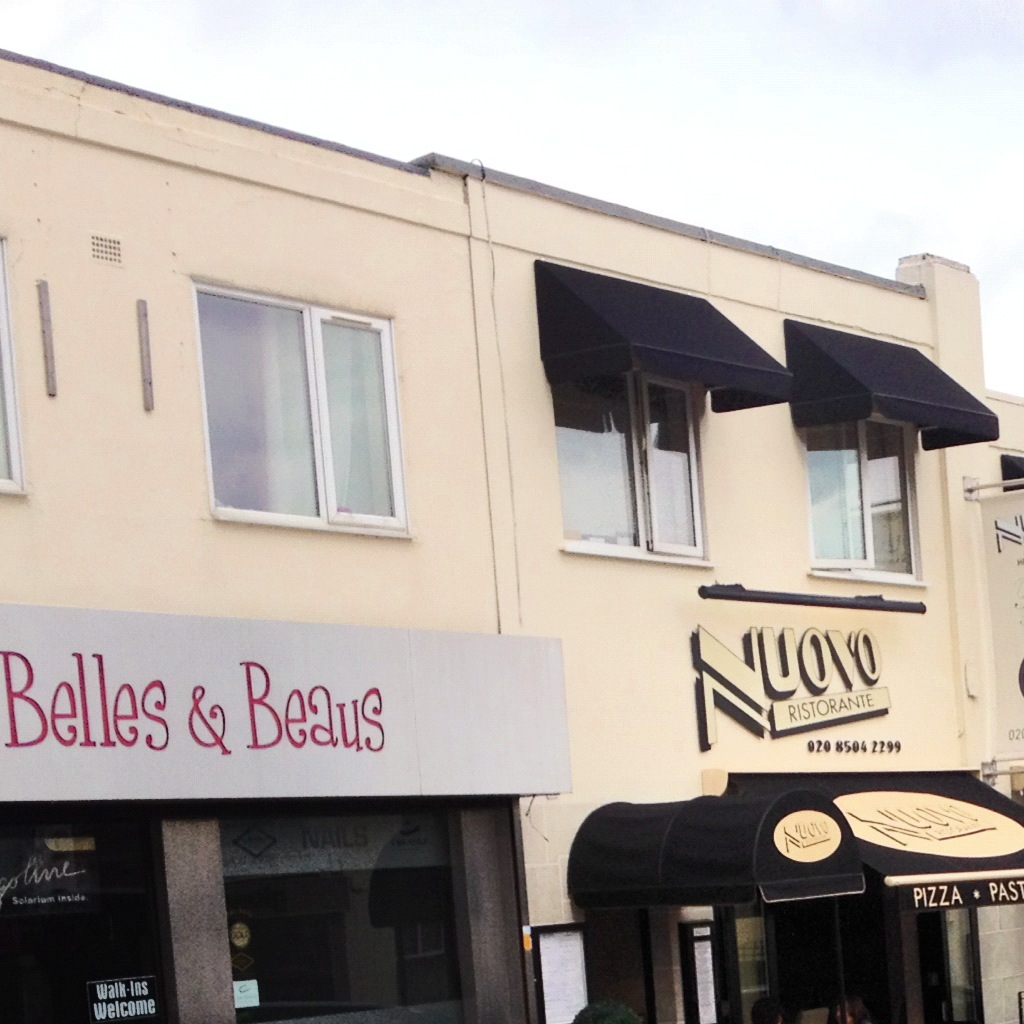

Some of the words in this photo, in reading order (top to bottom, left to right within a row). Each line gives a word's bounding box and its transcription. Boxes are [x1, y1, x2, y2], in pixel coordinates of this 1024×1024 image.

[690, 624, 882, 752] NUOVO
[2, 650, 169, 751] Belles
[188, 684, 232, 756] &
[239, 661, 385, 753] Beaus
[788, 694, 874, 723] RISTORANTE
[807, 741, 831, 753] 020
[835, 741, 868, 753] 8504
[871, 741, 902, 754] 2299
[913, 886, 963, 908] PIZZA
[96, 980, 149, 1000] Walk-Ins
[93, 998, 156, 1021] Welcome
